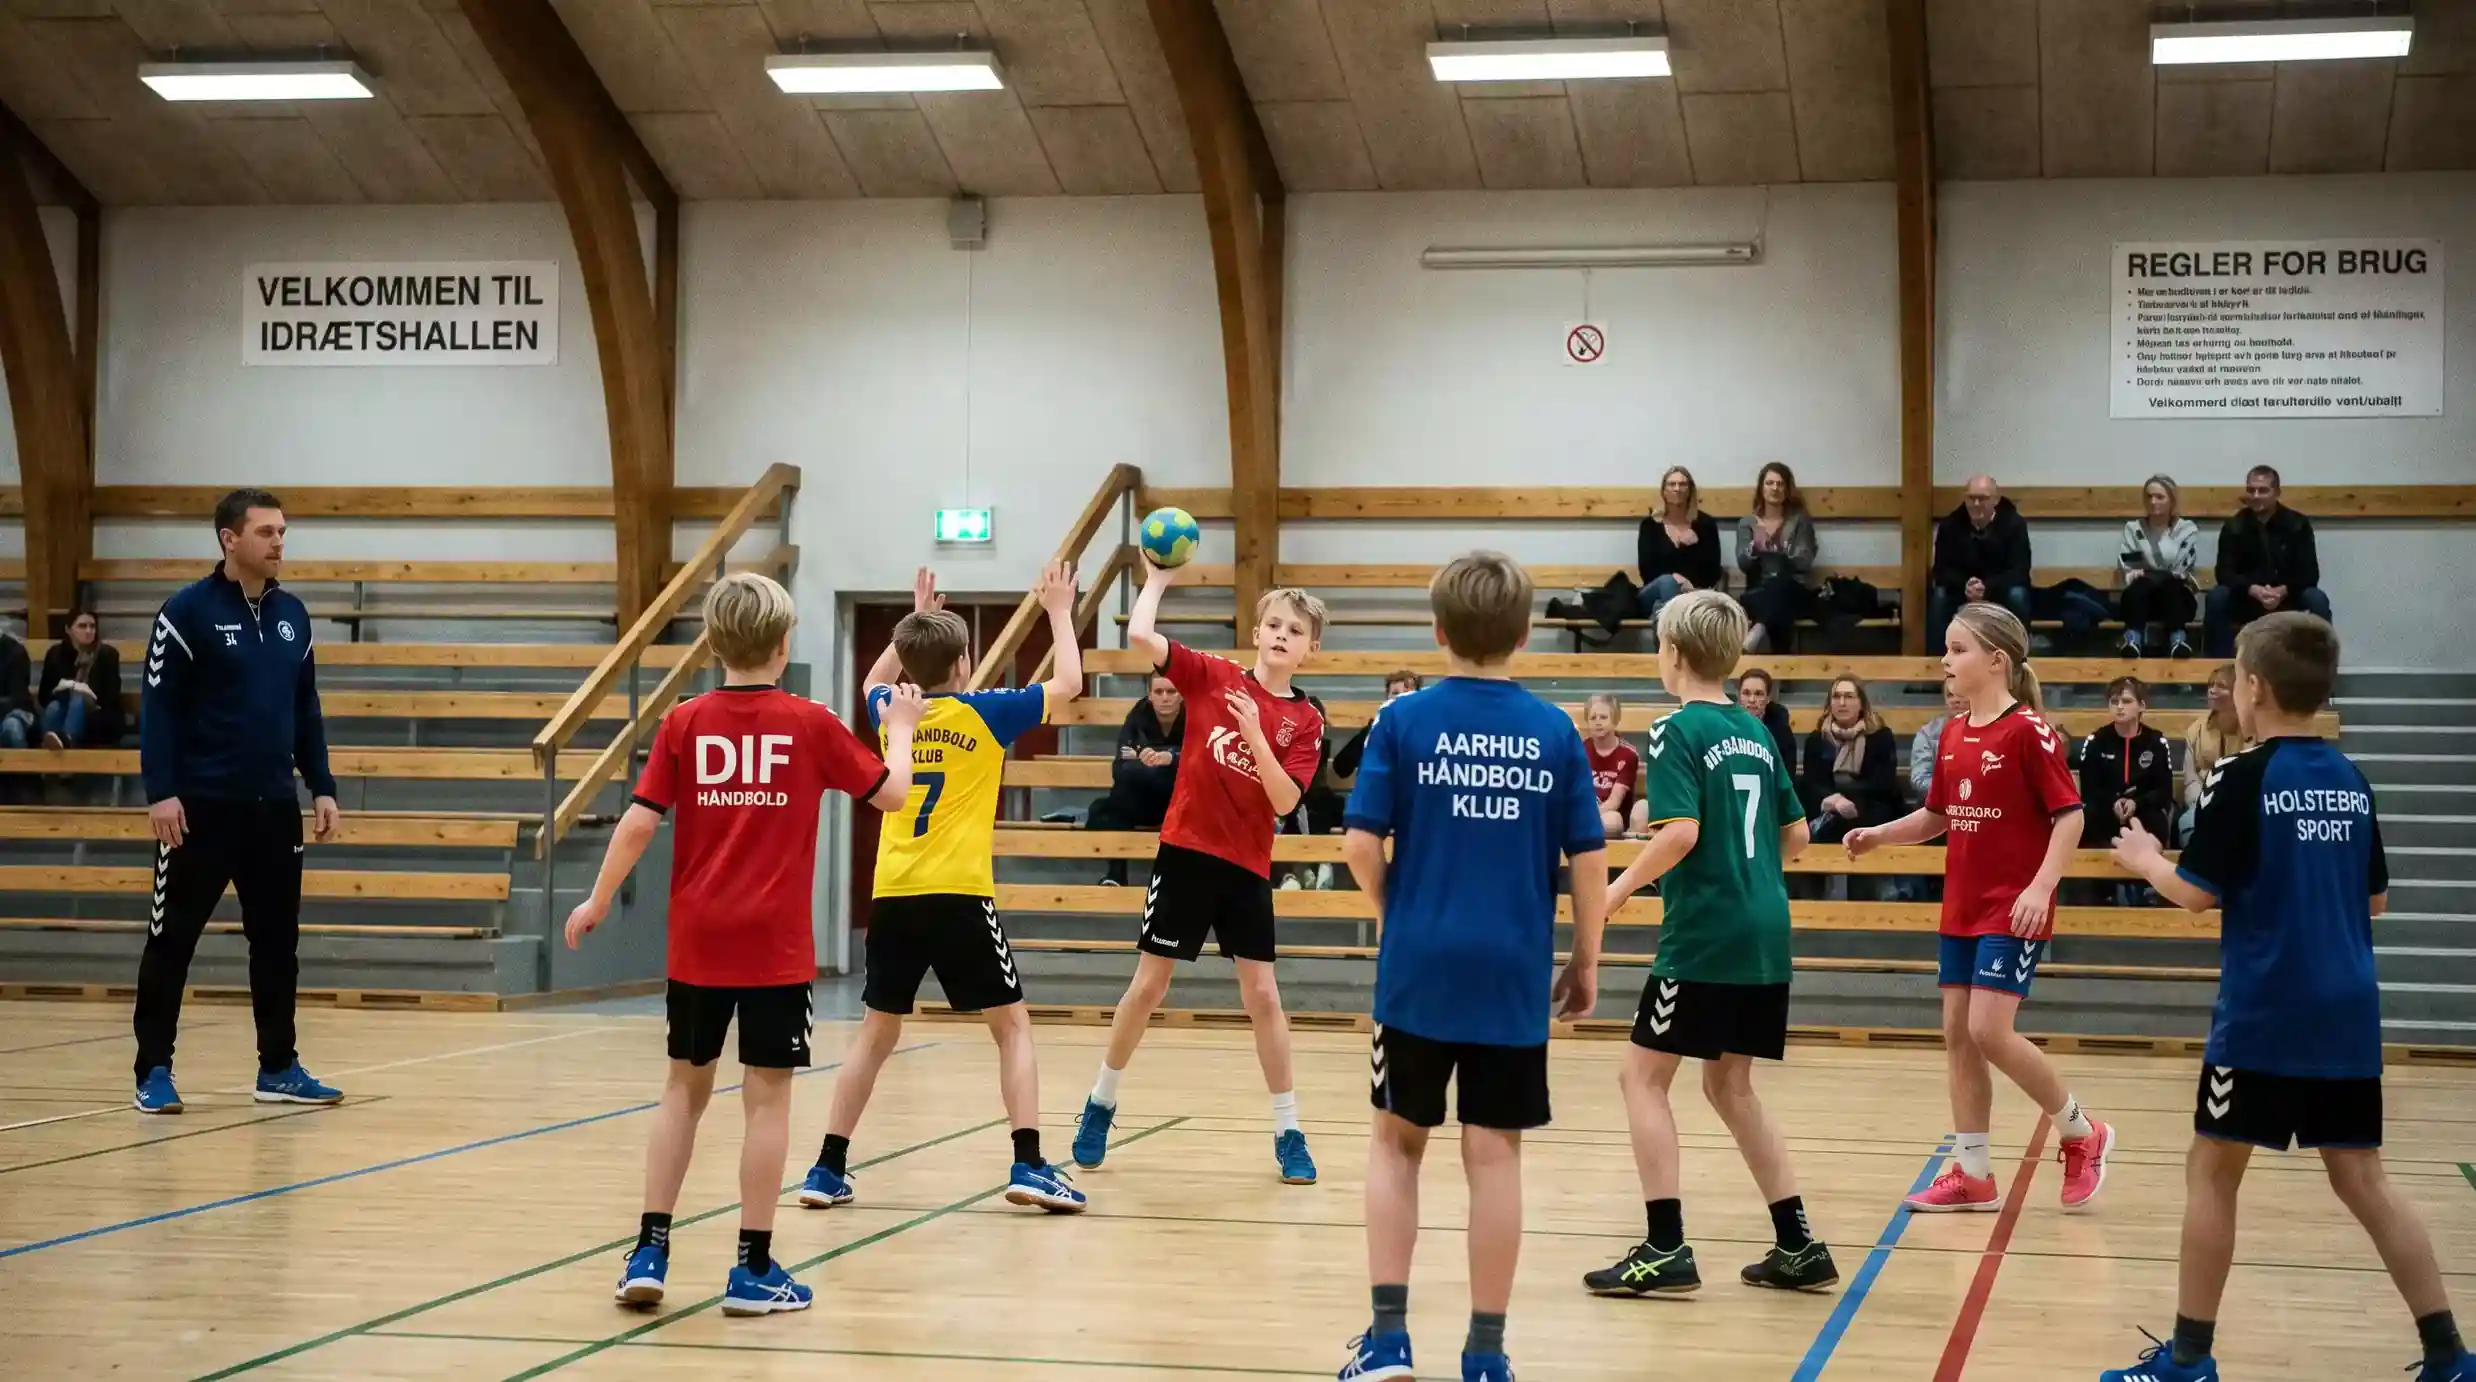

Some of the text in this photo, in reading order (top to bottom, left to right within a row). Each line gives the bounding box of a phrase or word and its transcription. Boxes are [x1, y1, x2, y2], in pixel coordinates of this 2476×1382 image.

[2128, 249, 2428, 278] REGLER FOR BRUG
[258, 275, 544, 306] VELKOMMEN TIL
[261, 320, 538, 351] IDRÆTSHALLEN
[696, 734, 793, 785] DIF
[1434, 732, 1541, 760] AARHUS
[1418, 757, 1554, 793] HÅNDBOLD
[912, 771, 946, 838] 7
[1452, 794, 1520, 820] KLUB
[1731, 773, 1761, 859] 7
[2297, 818, 2353, 842] SPORT
